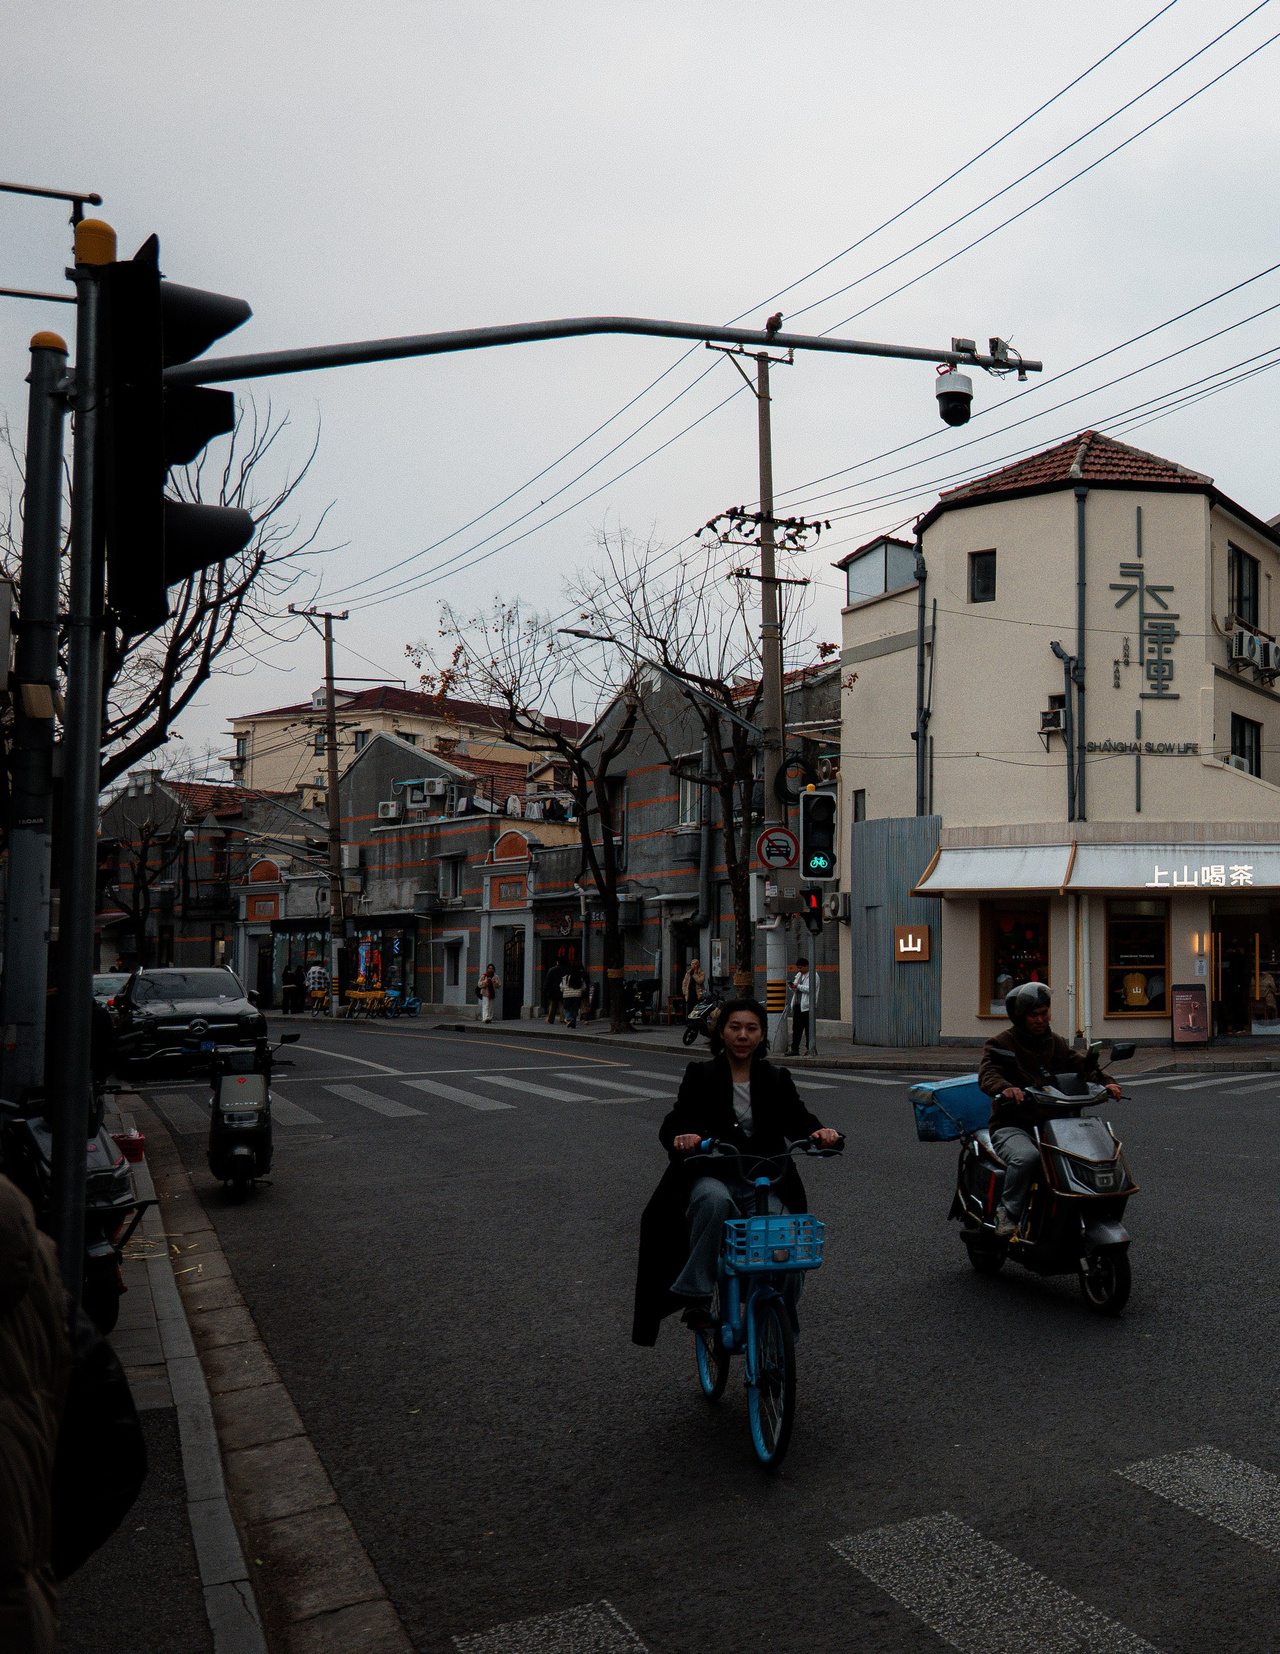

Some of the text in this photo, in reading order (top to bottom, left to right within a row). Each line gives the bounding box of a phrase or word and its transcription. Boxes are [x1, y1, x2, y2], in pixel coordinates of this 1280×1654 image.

[1086, 740, 1199, 754] SHANGHAI SLOW LIFE
[1145, 864, 1254, 889] 上山喝茶
[899, 933, 922, 953] 山
